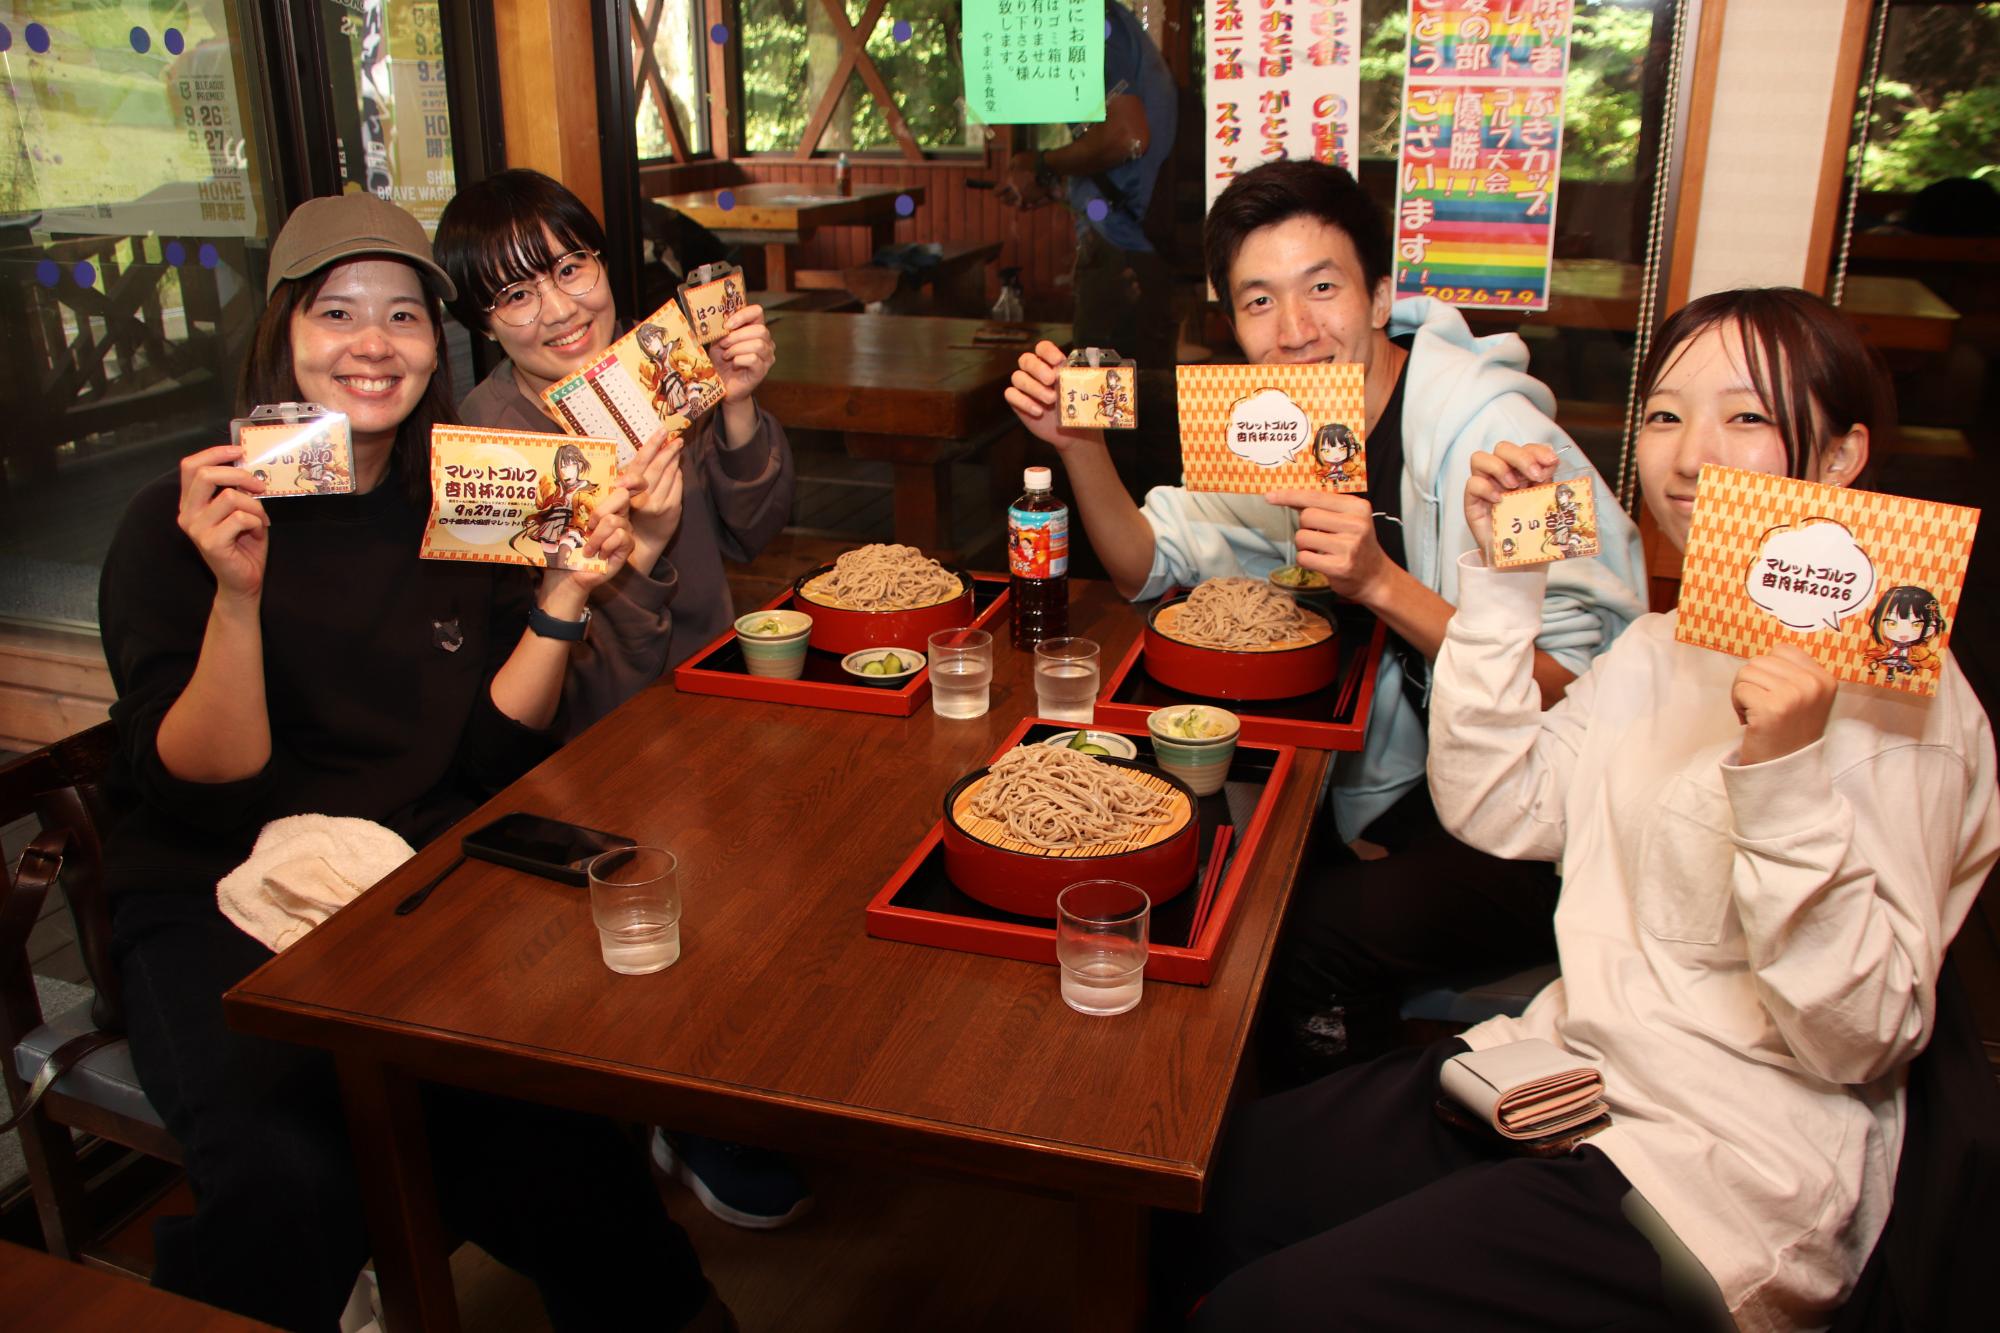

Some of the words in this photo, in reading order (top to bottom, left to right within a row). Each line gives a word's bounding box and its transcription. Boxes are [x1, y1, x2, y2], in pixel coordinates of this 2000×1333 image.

[1031, 0, 1045, 79] 有りません
[1068, 0, 1087, 102] にお願い！
[184, 105, 223, 126] 9.26
[198, 181, 245, 200] HOME
[1236, 420, 1298, 431] マレットゴルフ
[1237, 431, 1297, 443] 杏月杯2026
[444, 464, 537, 483] マレットゴルフ
[445, 481, 536, 500] 杏月杯2026
[1766, 558, 1857, 585] マレットゴルフ
[1762, 572, 1853, 601] 杏月杯2026
